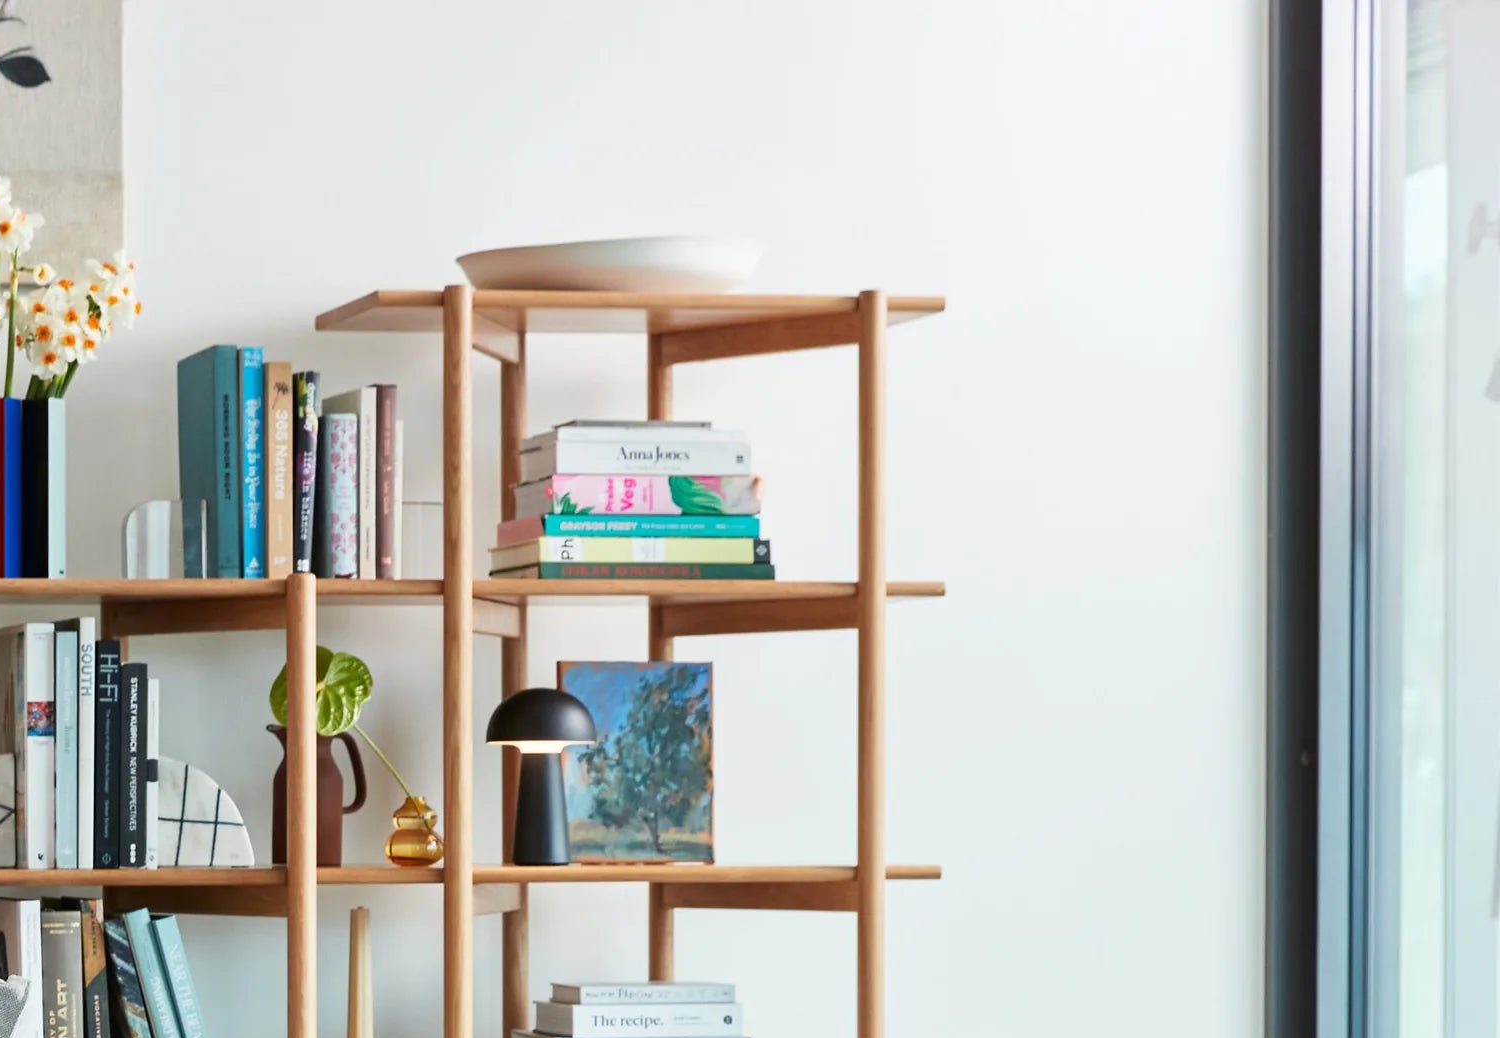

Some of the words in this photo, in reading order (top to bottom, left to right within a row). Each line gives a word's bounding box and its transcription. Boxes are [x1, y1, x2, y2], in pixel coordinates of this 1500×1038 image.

[222, 393, 232, 438] MORNING
[274, 409, 289, 441] 365
[223, 441, 232, 468] NOON
[274, 444, 289, 500] Nature
[303, 451, 315, 476] life
[618, 446, 653, 461] Anna
[655, 446, 690, 464] Jones
[223, 471, 233, 500] NIGHT
[301, 480, 313, 492] in
[620, 477, 637, 512] Veg
[299, 496, 313, 541] balance
[80, 643, 94, 697] SOUTH
[99, 653, 119, 703] Hi-Fi
[130, 677, 138, 715] STANLEY
[63, 726, 73, 754] home
[129, 715, 138, 752] KUBRICK
[129, 756, 138, 775] NEW
[129, 776, 137, 830] PERSPECTIVES
[166, 943, 189, 982] NEAR
[178, 984, 199, 1011] THE
[56, 979, 68, 1019] ART
[49, 1009, 57, 1025] OF
[591, 1014, 617, 1027] The
[620, 1014, 665, 1030] recipe.
